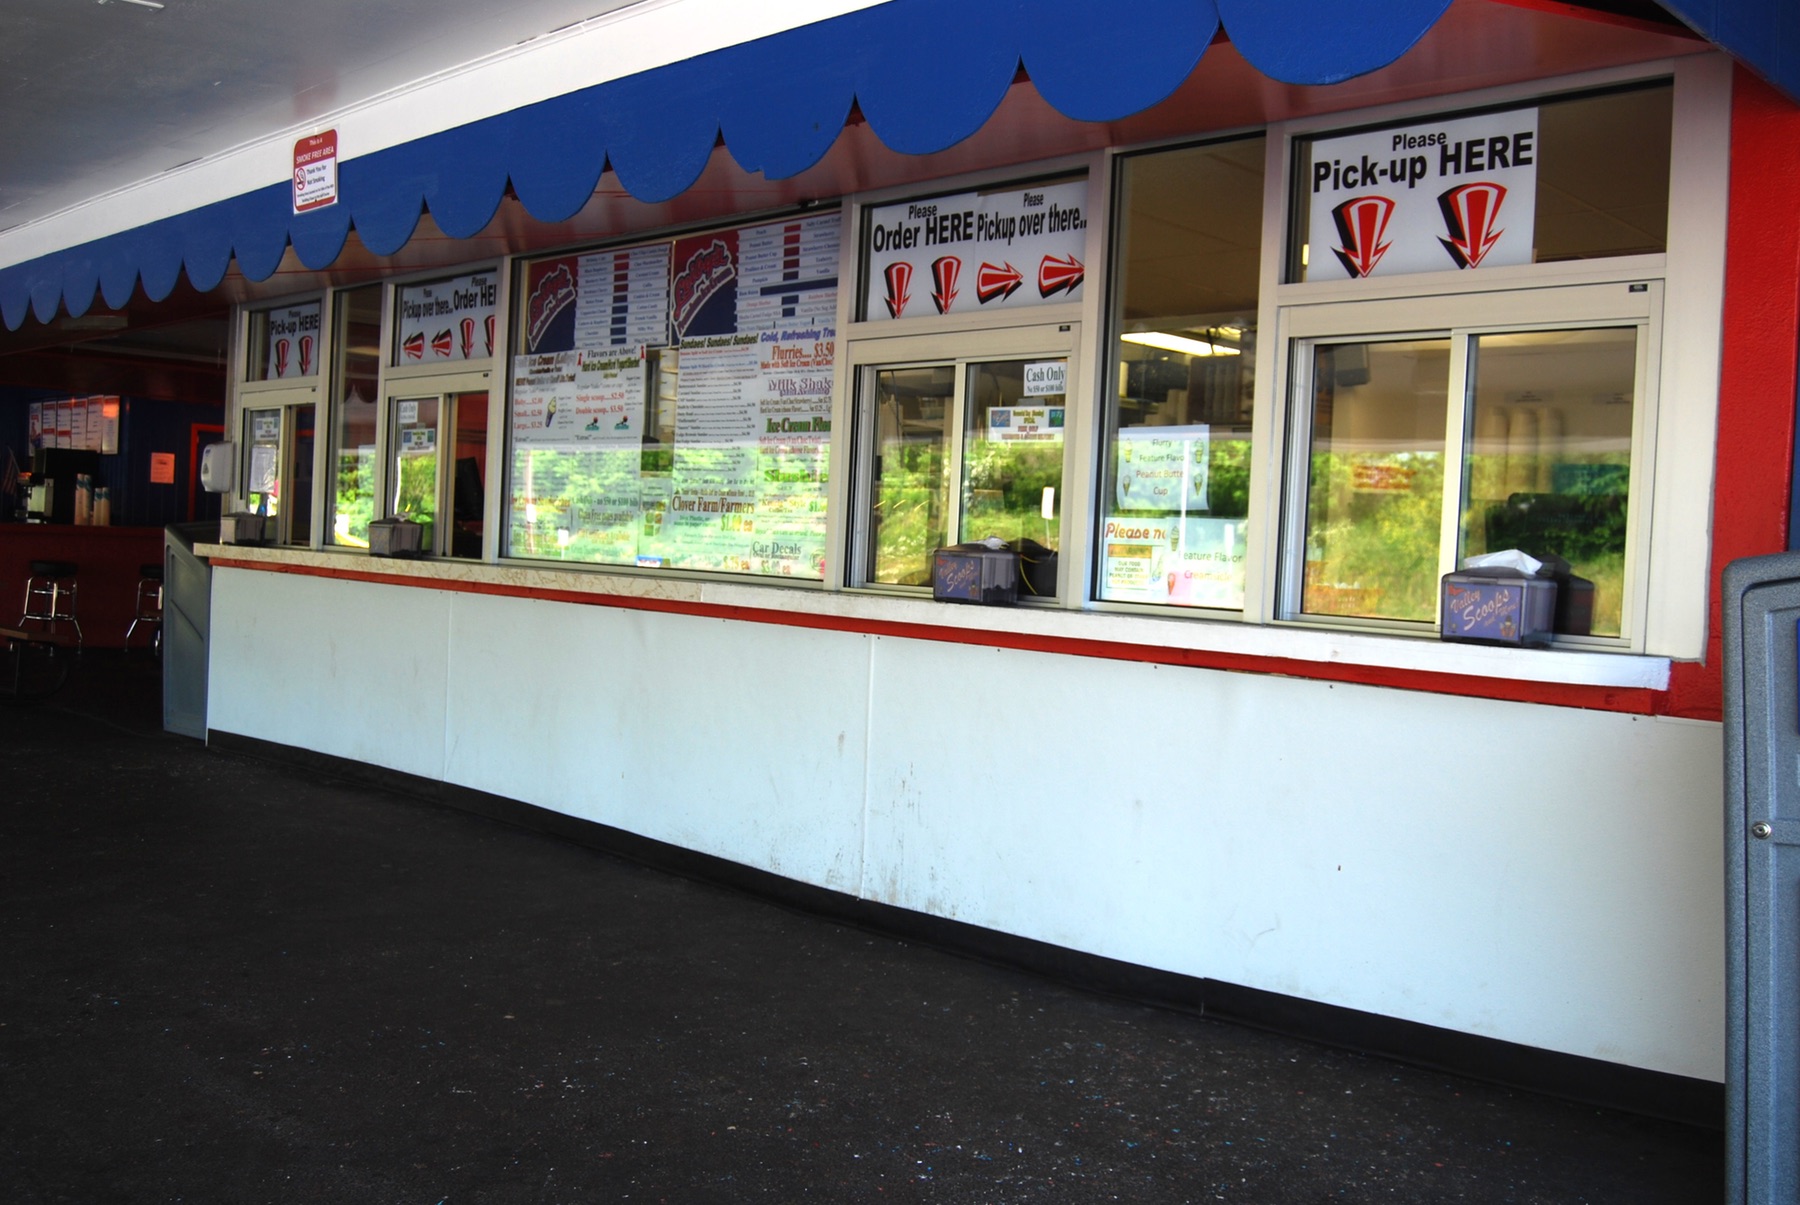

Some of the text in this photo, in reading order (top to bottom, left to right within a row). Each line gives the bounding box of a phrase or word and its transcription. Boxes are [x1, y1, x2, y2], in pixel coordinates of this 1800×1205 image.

[1391, 131, 1447, 152] Please
[296, 146, 334, 164] SMOKE FREE AREA
[1312, 131, 1533, 193] Pick-up HERE
[1023, 192, 1044, 208] Please
[908, 203, 938, 220] Please
[872, 211, 974, 253] Order HERE
[976, 211, 1016, 246] Pickup
[1018, 212, 1046, 237] over
[471, 276, 488, 287] Please
[453, 289, 478, 310] Order
[288, 309, 302, 319] Please
[402, 300, 421, 322] Pickup
[422, 301, 434, 318] over
[270, 313, 320, 336] Pick-up HERE
[760, 330, 779, 344] Cold,
[587, 349, 608, 360] Flavors
[813, 340, 835, 360] $3.50
[1026, 366, 1066, 385] Cash Only
[768, 378, 797, 392] Milk
[766, 417, 780, 433] Ice
[780, 416, 811, 433] Cream
[1152, 438, 1172, 448] Flurry
[1139, 454, 1165, 463] Feature
[1135, 470, 1162, 479] Peanut
[1153, 486, 1168, 496] Cup
[672, 495, 755, 515] Clover Farm/Farmers
[1105, 522, 1150, 540] Please
[752, 540, 802, 555] Car Decals
[1463, 588, 1510, 631] Scoops
